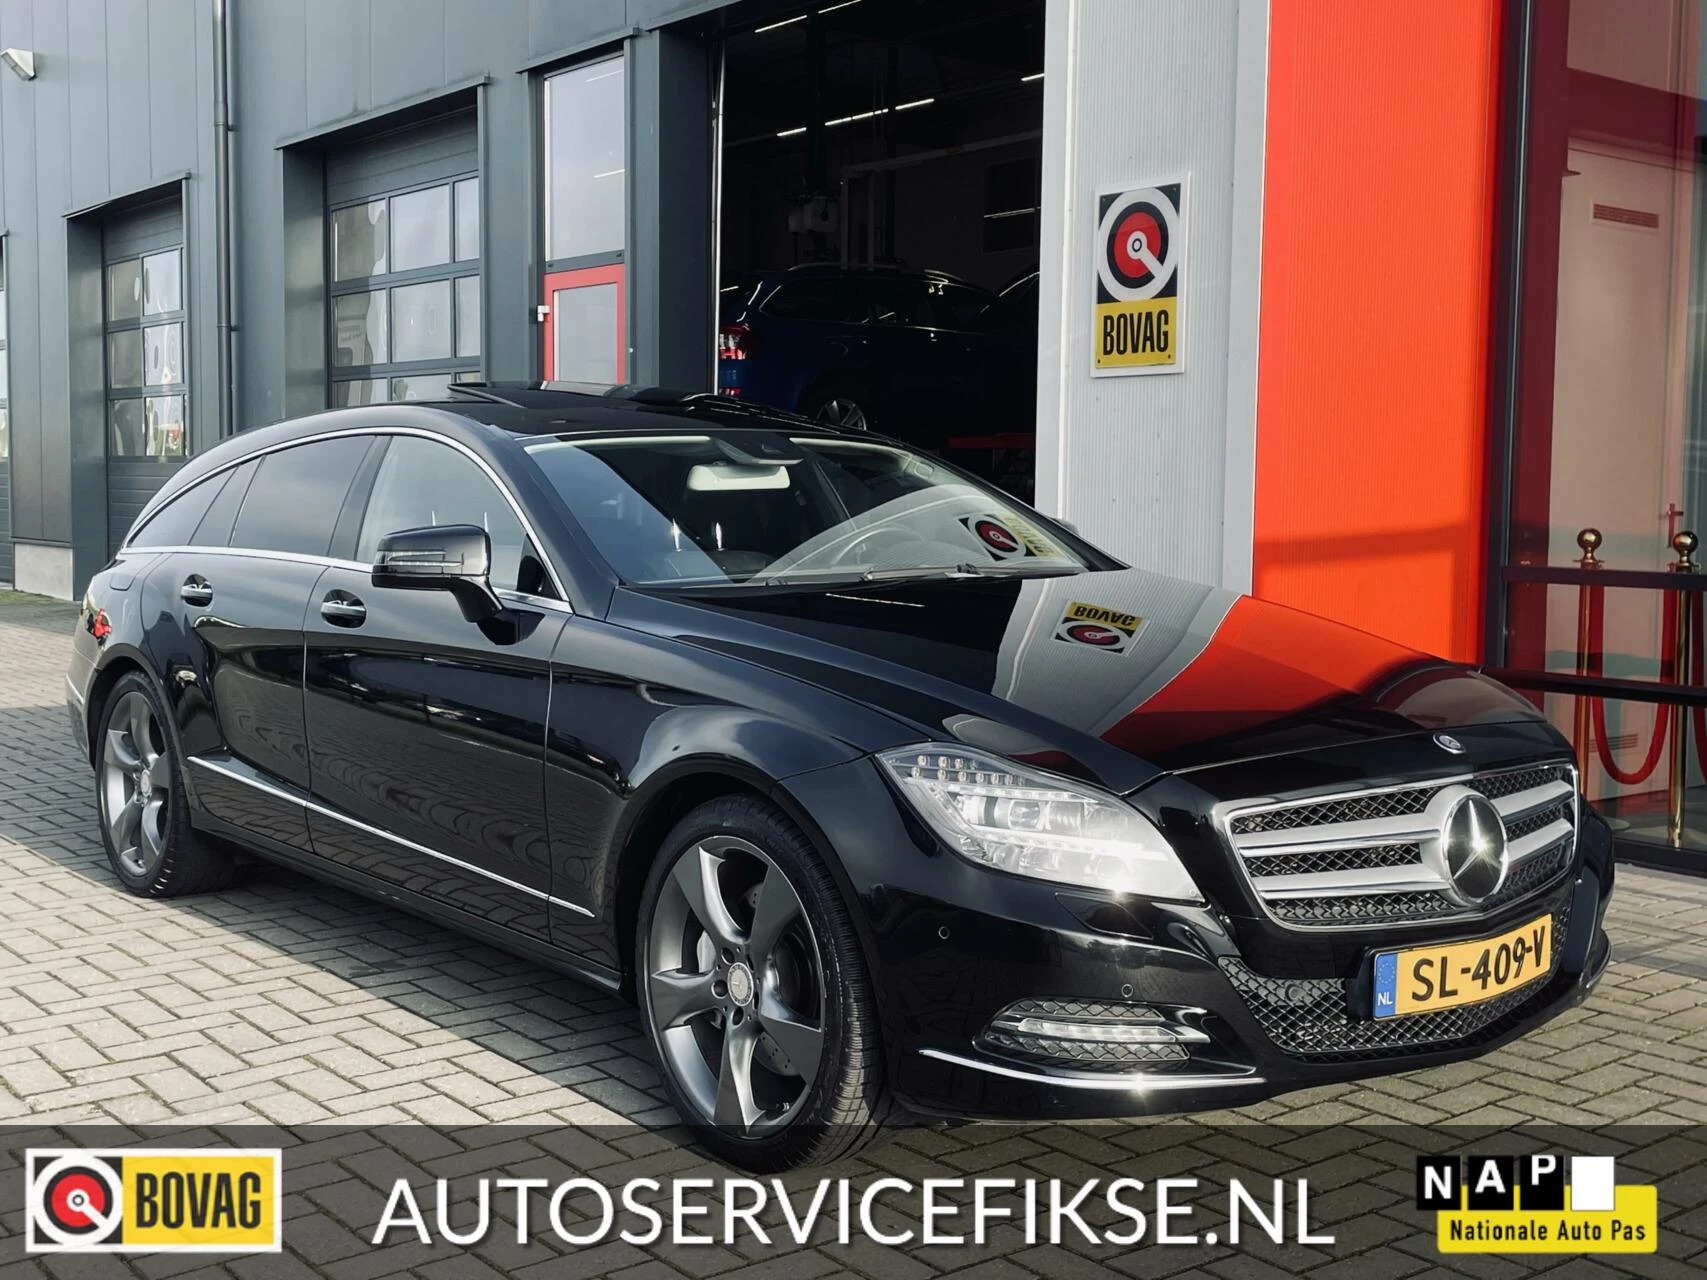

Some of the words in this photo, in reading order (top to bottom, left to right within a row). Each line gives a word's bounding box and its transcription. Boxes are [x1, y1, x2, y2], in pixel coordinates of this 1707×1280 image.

[1103, 309, 1169, 356] BOVAG
[1411, 925, 1545, 1002] SL-409-V
[1377, 991, 1393, 1006] NL
